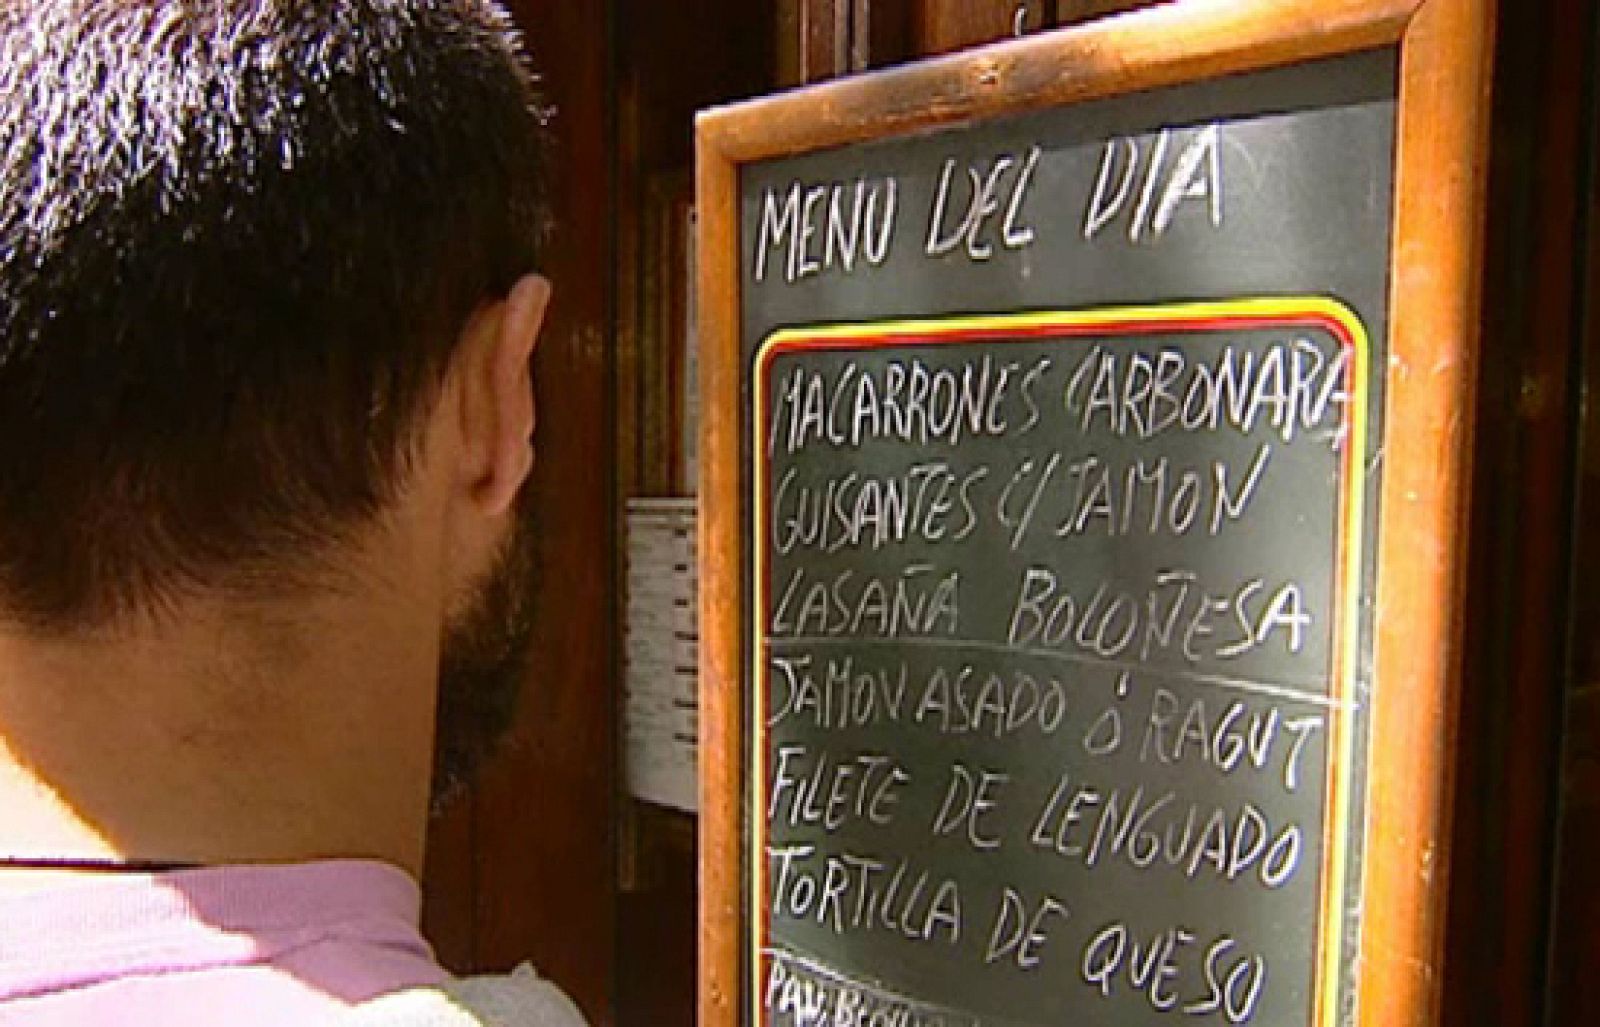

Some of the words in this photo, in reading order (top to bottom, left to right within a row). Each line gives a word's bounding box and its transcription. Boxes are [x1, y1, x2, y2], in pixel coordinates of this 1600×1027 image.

[753, 176, 897, 284] MENU
[925, 145, 1042, 260] DEL
[1083, 122, 1223, 241] DIA
[768, 353, 1051, 456] MACARRONES
[1064, 338, 1352, 450] CARBONARA
[773, 464, 989, 554] GUISANTES
[1054, 444, 1272, 537] JAMON
[772, 564, 960, 640] LASAÑA
[1007, 567, 1312, 663] BOLOÑESA
[915, 665, 1067, 736] ASADO
[1140, 690, 1324, 791] RAGUT
[767, 746, 911, 831] FILETE
[932, 763, 1010, 849] DE
[1031, 771, 1304, 888] LENGUADO
[766, 845, 962, 944] TORTILLA
[985, 887, 1070, 968] DE
[1083, 922, 1267, 1025] QUESO
